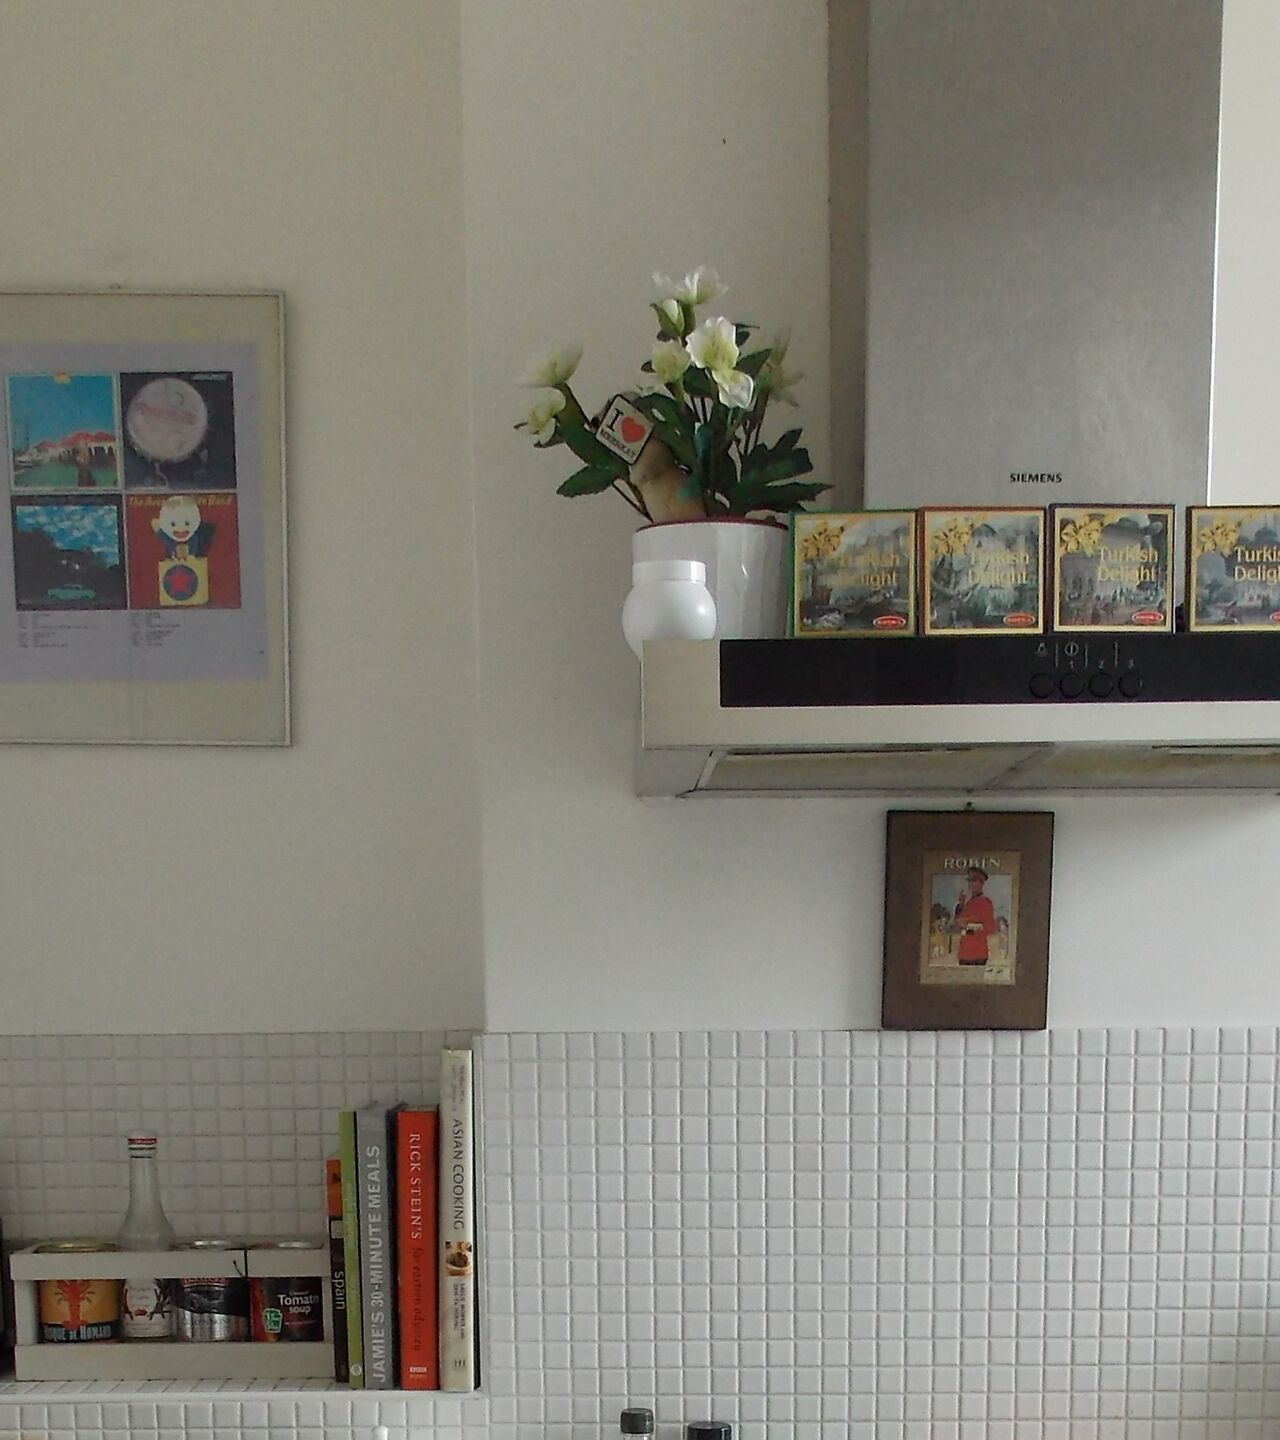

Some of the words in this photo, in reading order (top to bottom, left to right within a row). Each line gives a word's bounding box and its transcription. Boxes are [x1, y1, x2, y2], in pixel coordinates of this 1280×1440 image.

[1009, 472, 1063, 484] SIEMENS
[1098, 660, 1105, 669] 2
[1128, 659, 1135, 668] 3
[943, 856, 1002, 870] ROBIN
[409, 1133, 422, 1172] RICK
[452, 1118, 464, 1160] ASIAN
[365, 1144, 381, 1208] MEALS
[409, 1177, 423, 1240] STEIN'S
[452, 1164, 465, 1231] COOKING
[367, 1213, 384, 1308] 30-MINUTE
[277, 1294, 320, 1307] Tomato
[288, 1305, 312, 1315] soup
[333, 1270, 347, 1310] spain
[369, 1311, 387, 1384] JAMIE'S
